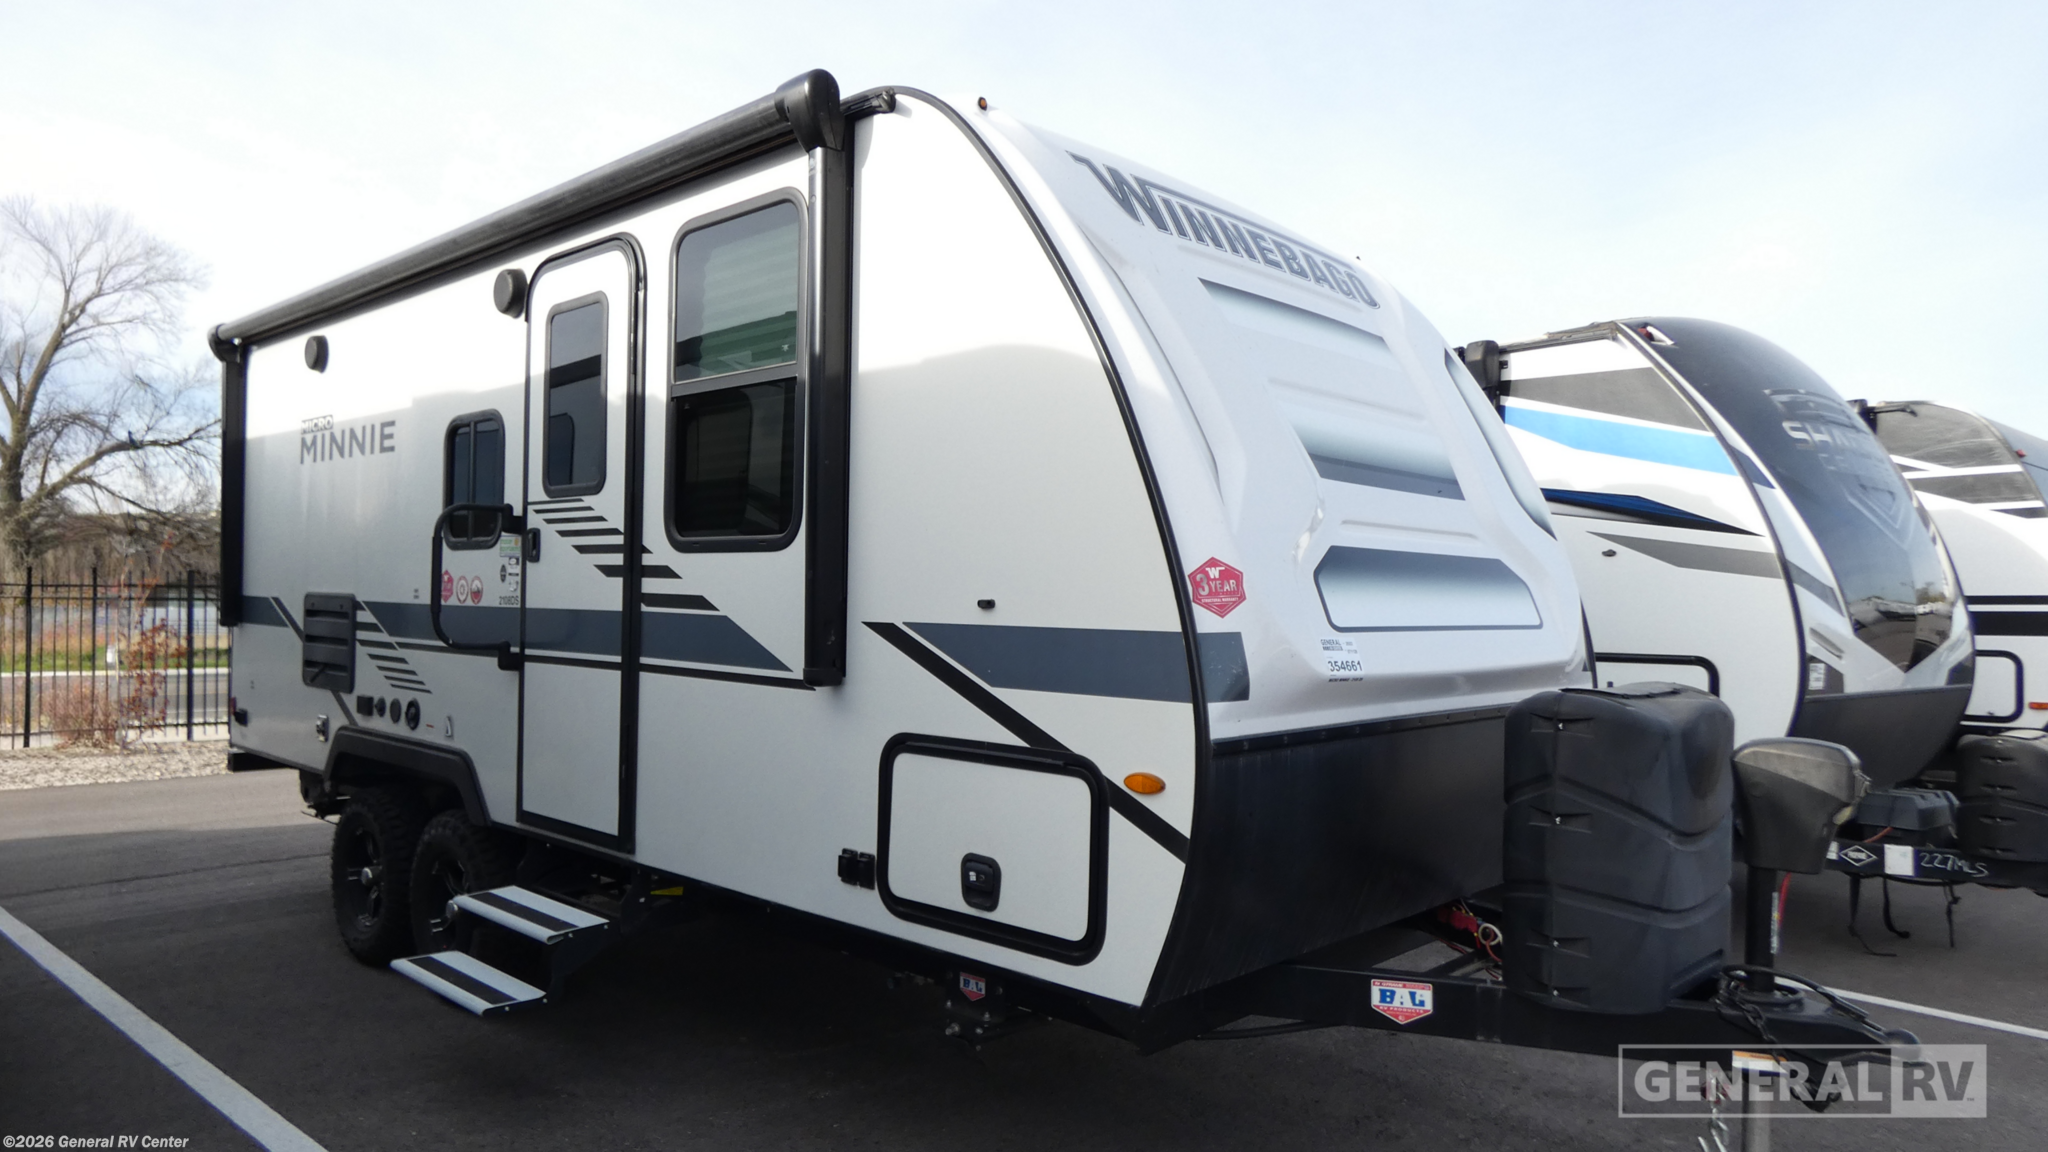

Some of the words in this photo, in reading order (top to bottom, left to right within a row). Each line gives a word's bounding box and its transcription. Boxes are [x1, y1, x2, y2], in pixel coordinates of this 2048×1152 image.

[1066, 150, 1381, 309] WINNEBAGO
[301, 415, 333, 434] MICRO
[300, 420, 396, 465] MINNIE
[1196, 573, 1210, 596] 3
[1209, 579, 1238, 593] YEAR
[1327, 660, 1363, 672] 354661
[1378, 988, 1426, 1007] BAL
